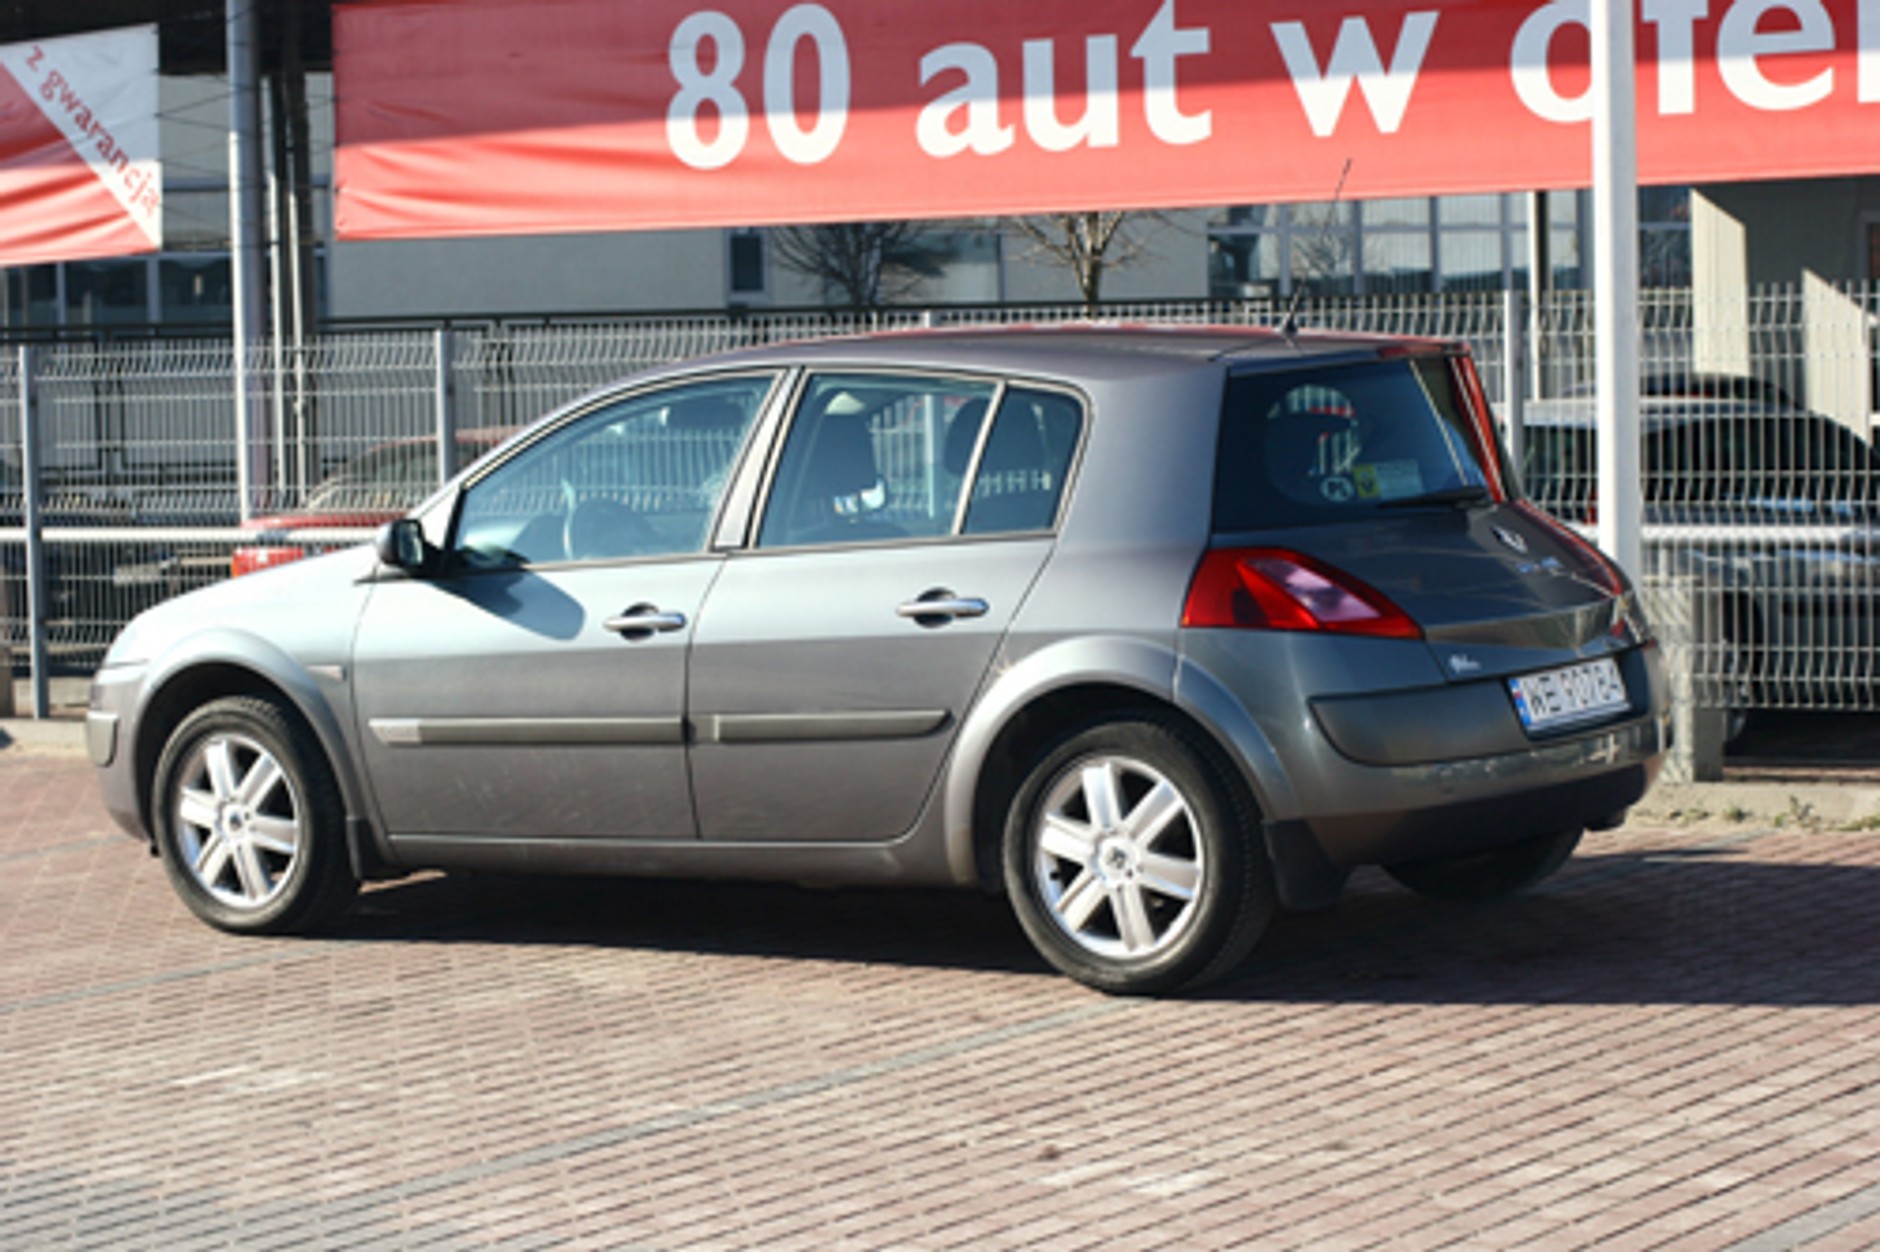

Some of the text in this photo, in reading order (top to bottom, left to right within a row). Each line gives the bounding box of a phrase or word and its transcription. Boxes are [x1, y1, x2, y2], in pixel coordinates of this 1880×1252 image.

[25, 44, 161, 217] z gwarancja
[666, 3, 851, 170] 80
[915, 0, 1212, 157] aut
[1270, 11, 1439, 137] w
